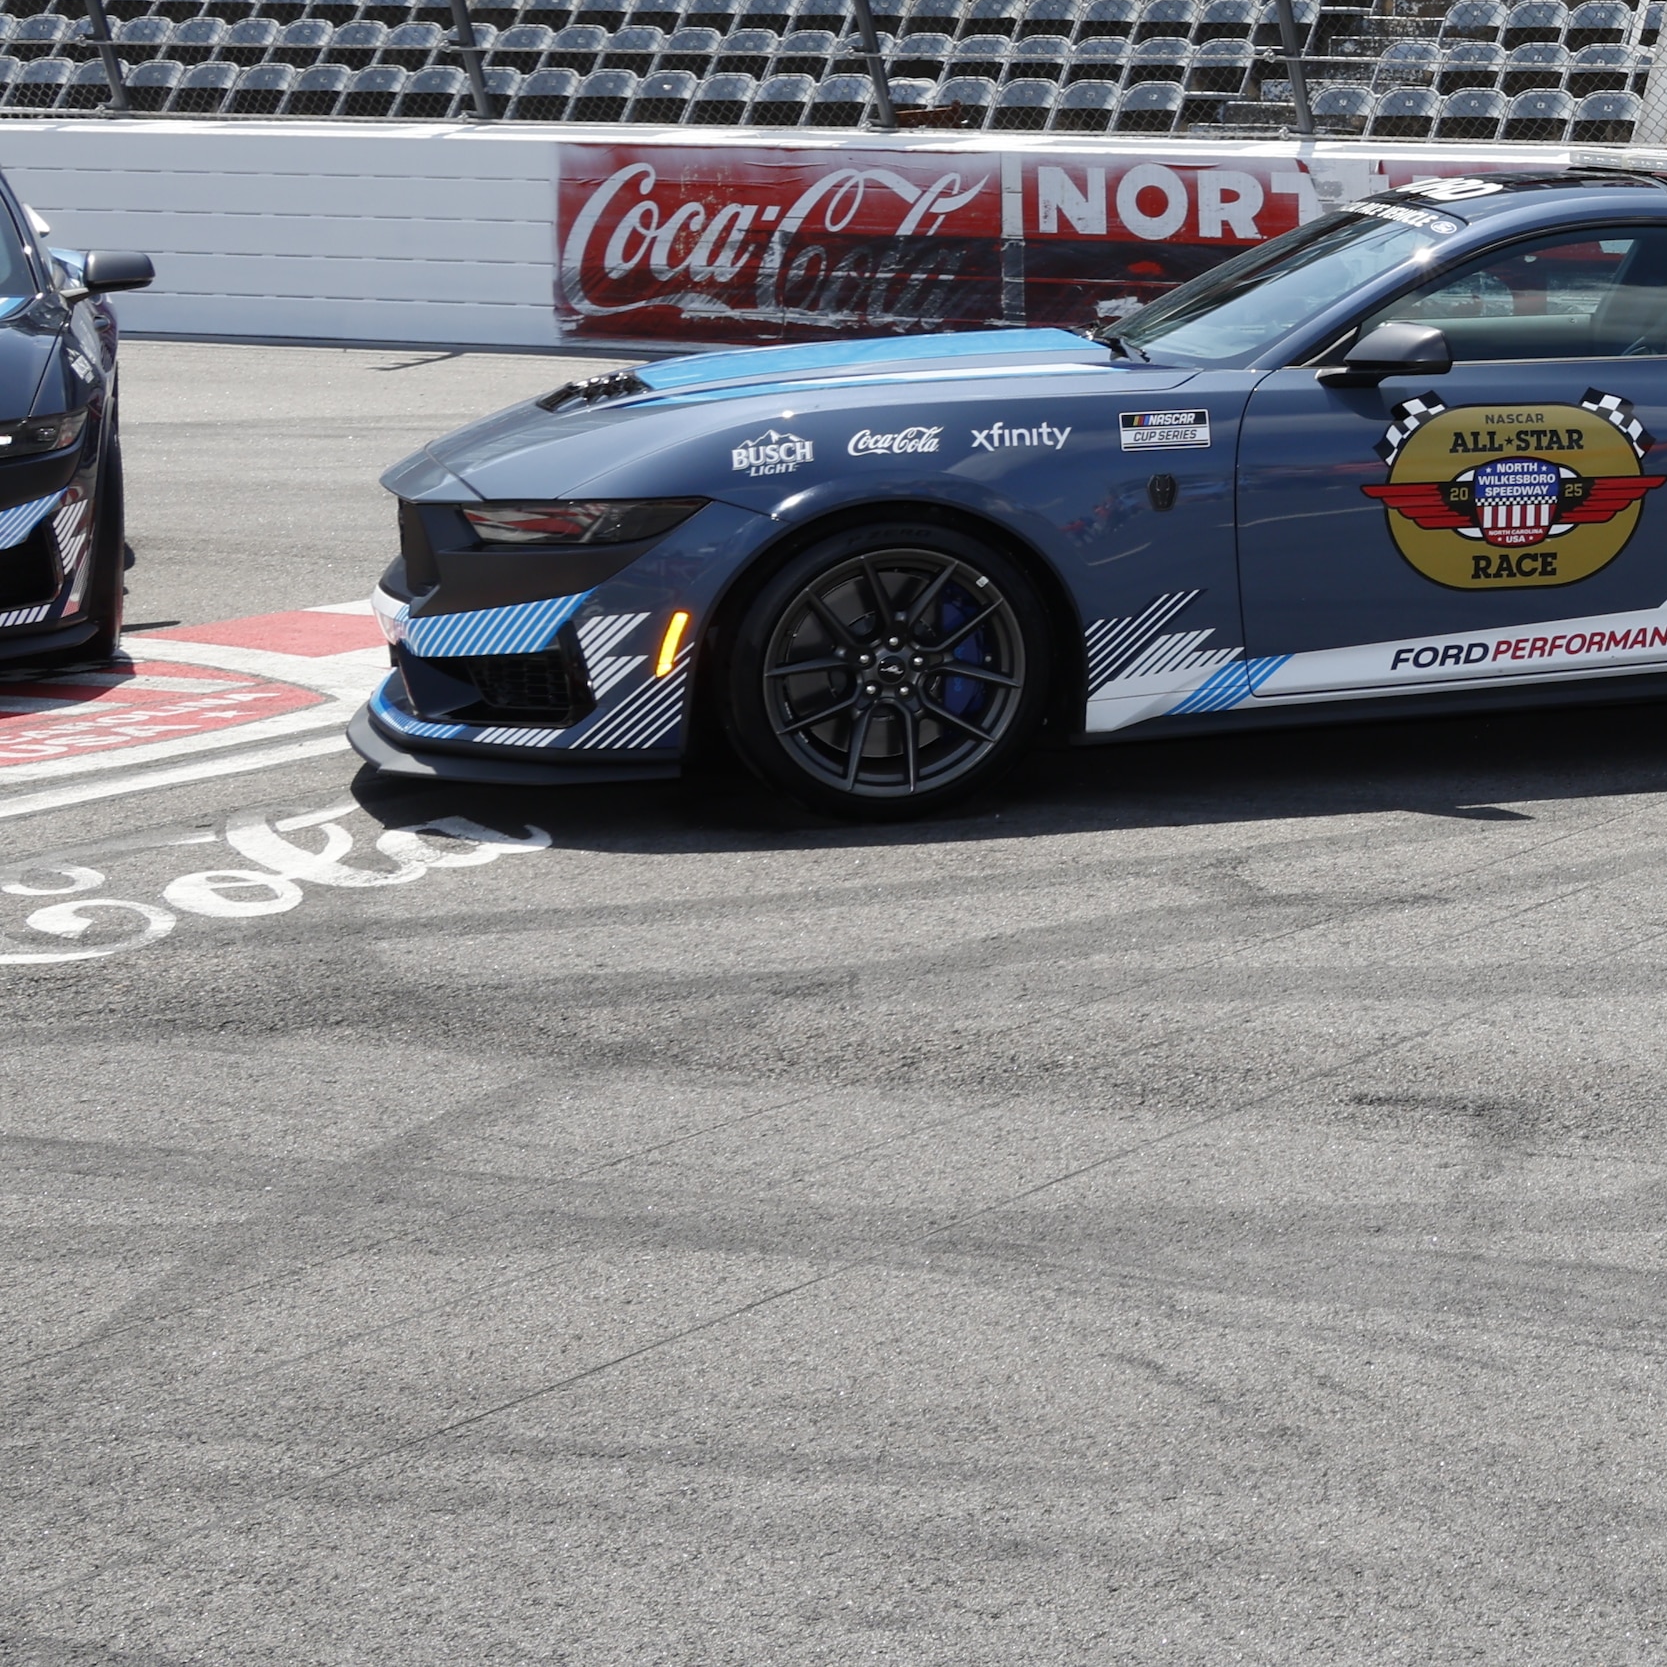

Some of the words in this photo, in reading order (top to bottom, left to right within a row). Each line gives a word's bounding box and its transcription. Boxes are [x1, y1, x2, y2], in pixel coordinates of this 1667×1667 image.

[1377, 205, 1440, 228] VEHICLE
[560, 162, 990, 329] Coca-Cola
[1148, 413, 1196, 426] NASCAR
[1485, 413, 1545, 425] NASCAR
[847, 425, 945, 457] Coca-Cola
[970, 421, 1073, 452] xfinity
[1133, 430, 1158, 443] CUP
[1158, 429, 1198, 441] SERIES
[1449, 431, 1504, 454] ALL
[1516, 429, 1585, 452] STAR
[731, 440, 815, 471] BUSCH
[749, 462, 798, 477] LIGHT
[1496, 462, 1538, 474] NORTH
[1478, 473, 1556, 485] WILKESBORO
[1450, 487, 1469, 501] 20
[1485, 485, 1549, 498] SPEEDWAY
[1564, 483, 1583, 497] 25
[1505, 535, 1526, 544] USA
[1471, 551, 1558, 580] RACE
[1390, 642, 1490, 671] FORD
